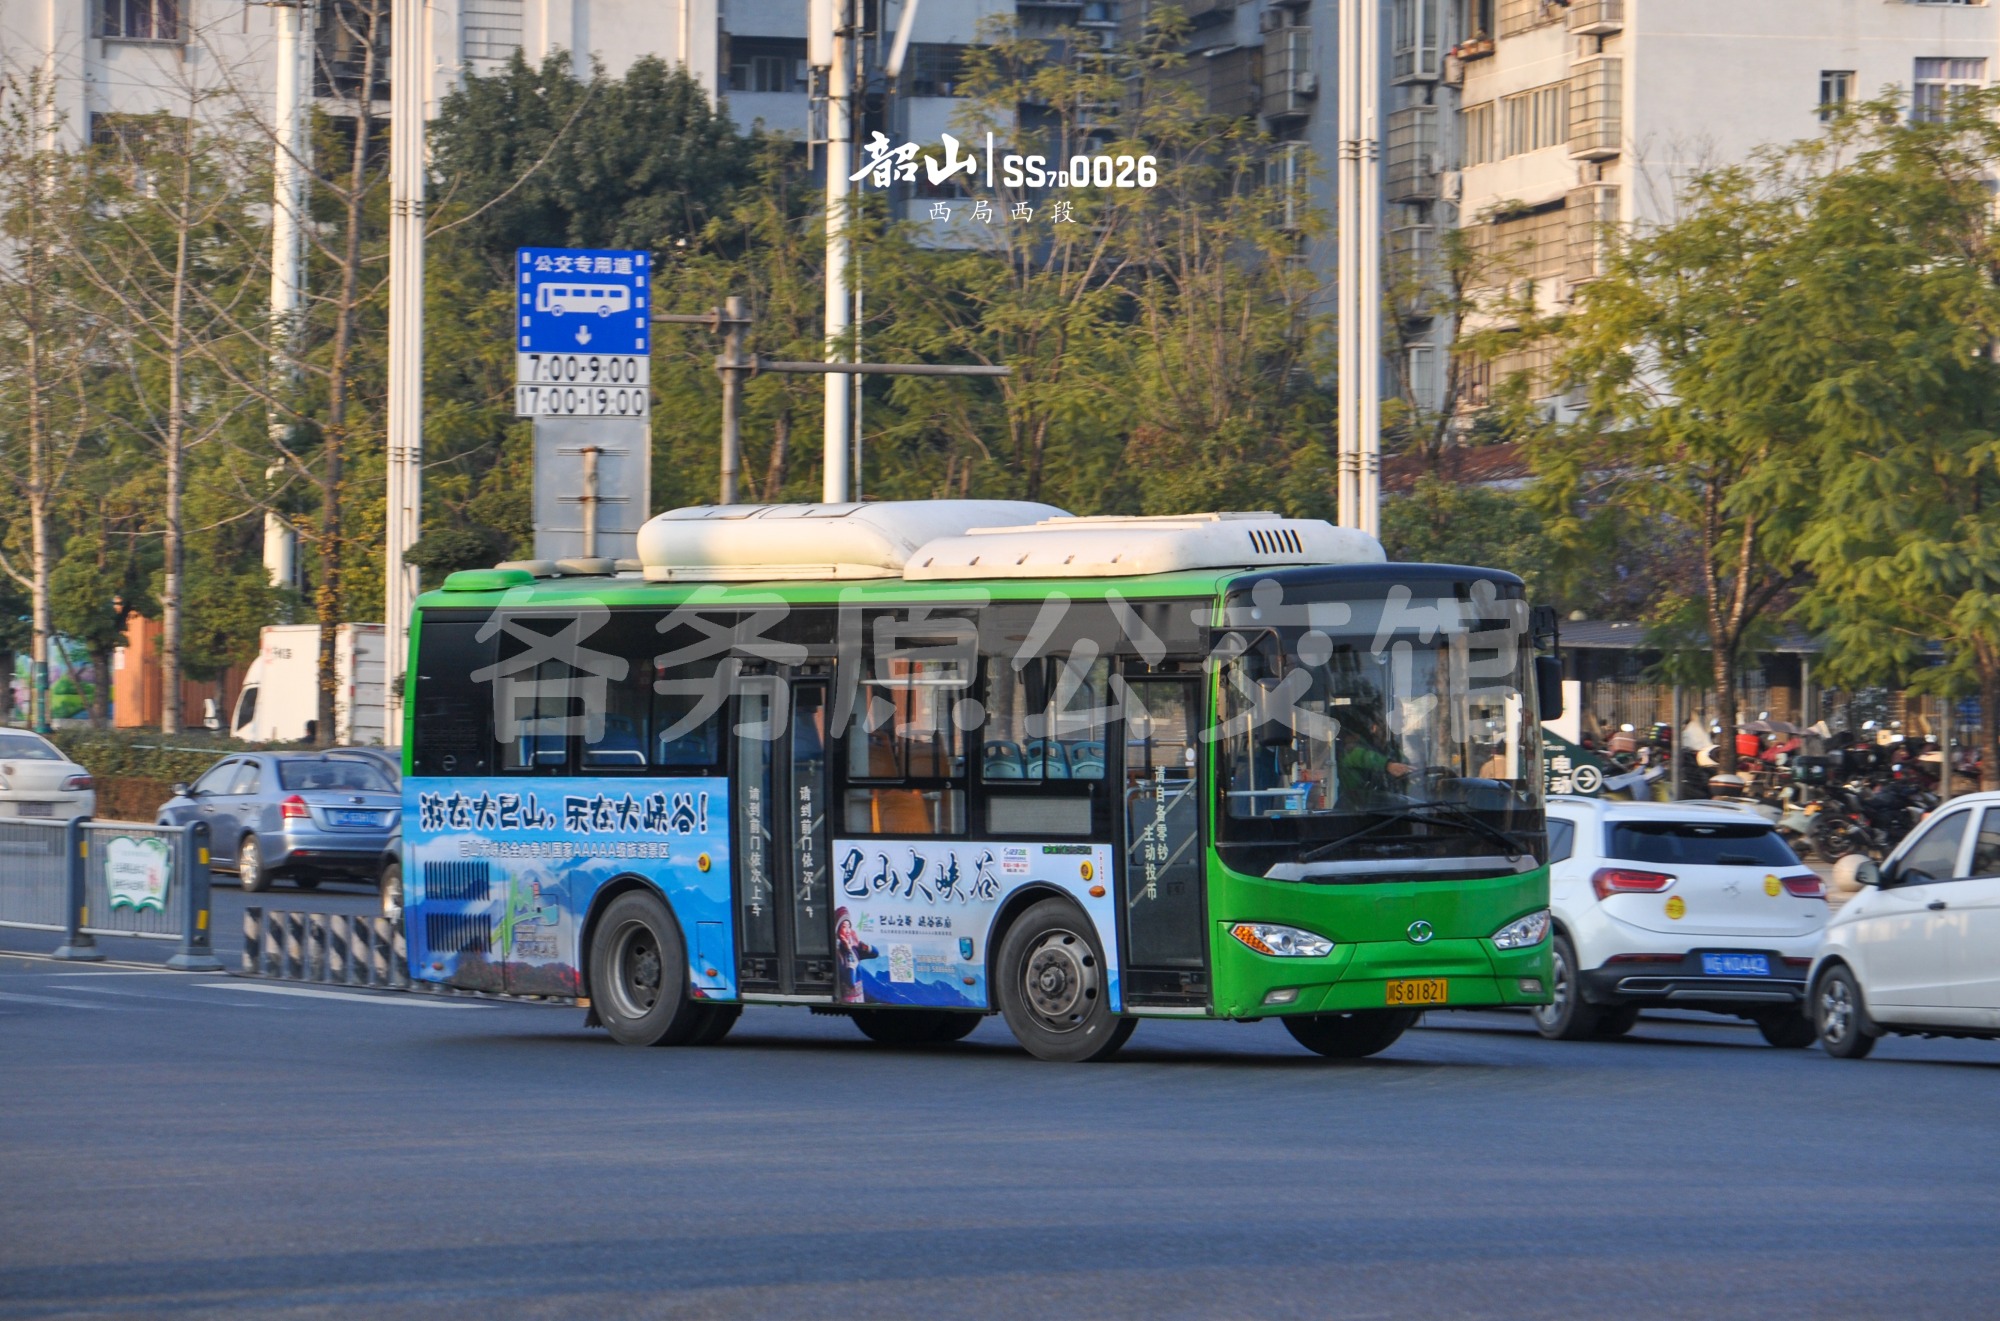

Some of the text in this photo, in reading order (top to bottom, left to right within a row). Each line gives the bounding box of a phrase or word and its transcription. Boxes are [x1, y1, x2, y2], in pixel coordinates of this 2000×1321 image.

[534, 254, 634, 275] 公交专用道
[529, 355, 638, 383] 7:00-9:00
[520, 387, 645, 415] 17:00-19:00
[1154, 766, 1169, 861] 请自备零钞
[839, 846, 1001, 904] 巴山大峡谷
[1144, 824, 1157, 900] 主动投币
